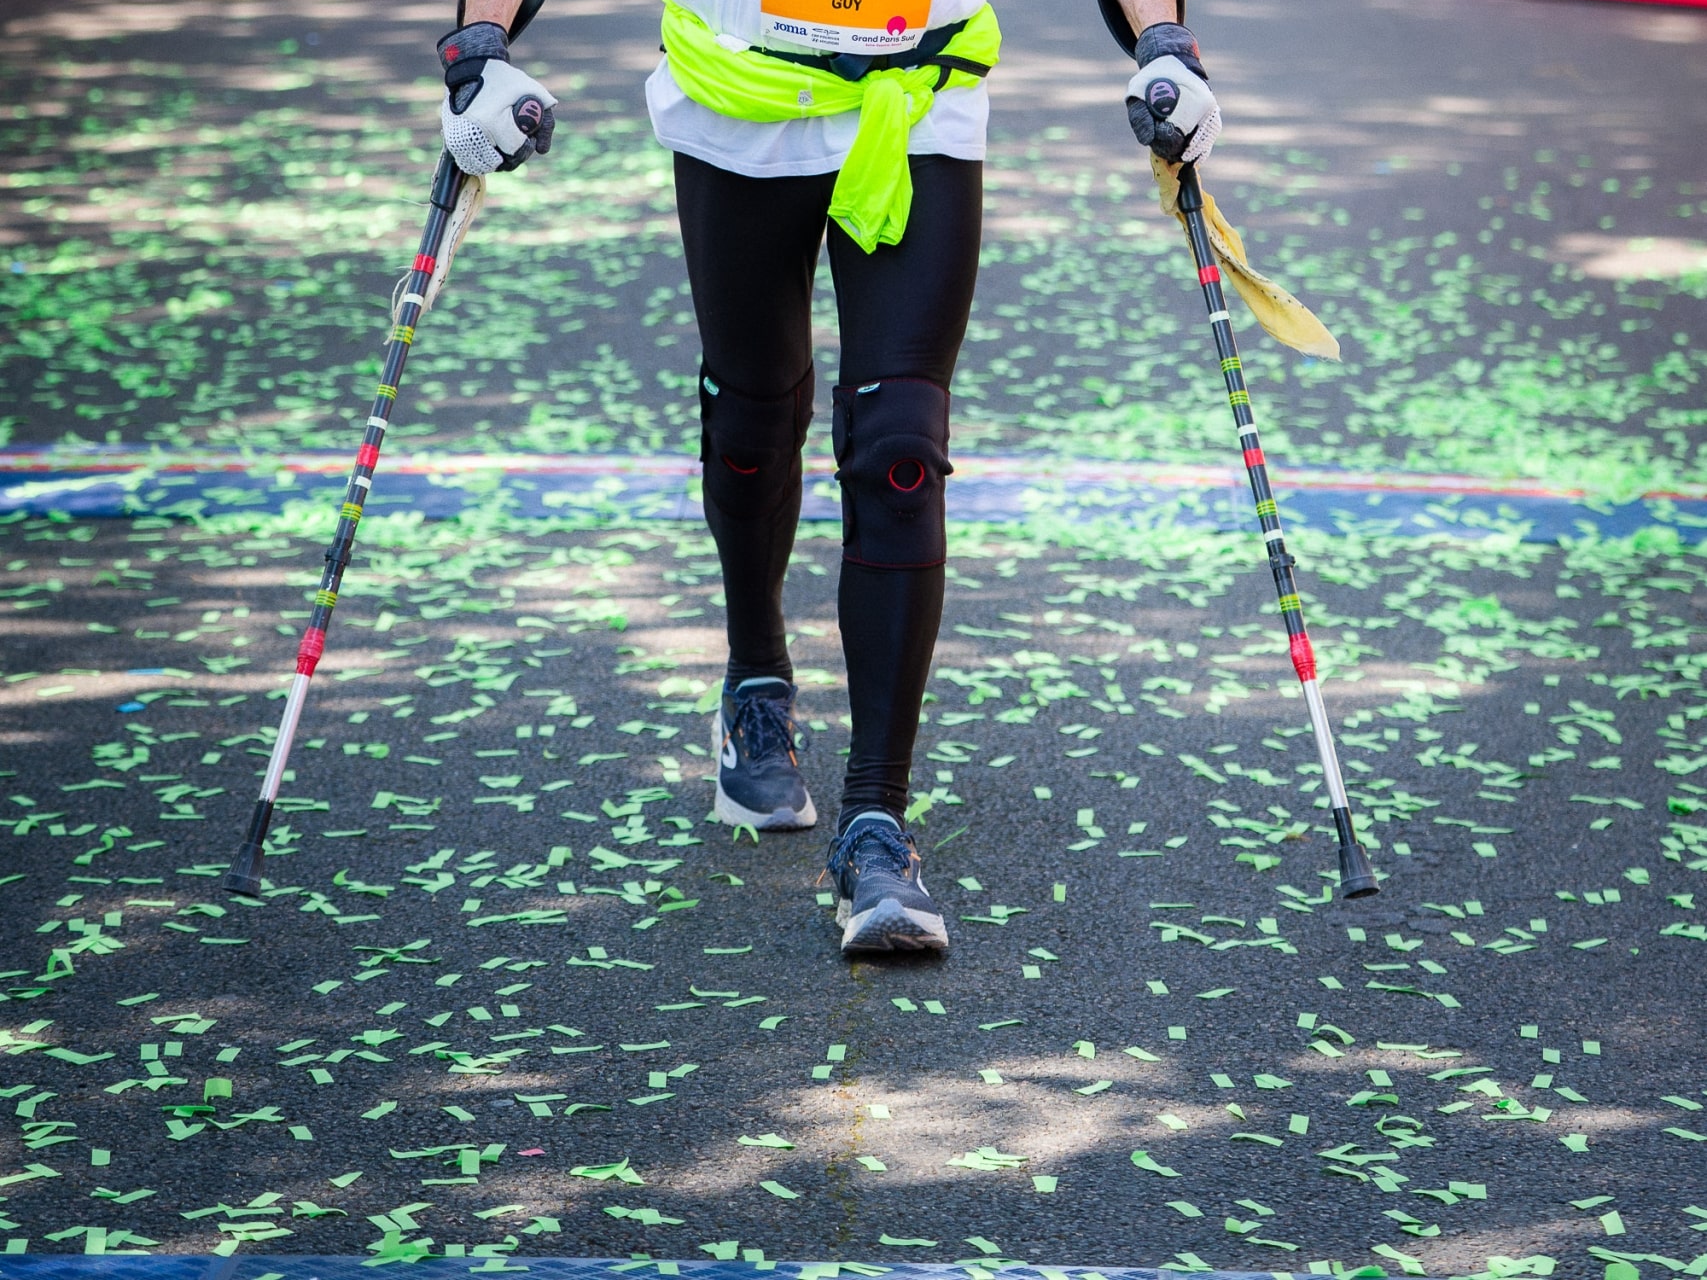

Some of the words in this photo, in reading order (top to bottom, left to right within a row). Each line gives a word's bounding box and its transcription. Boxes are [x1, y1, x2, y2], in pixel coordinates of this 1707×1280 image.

[851, 34, 879, 42] Grand
[880, 35, 899, 43] Paris
[901, 34, 916, 42] Sud
